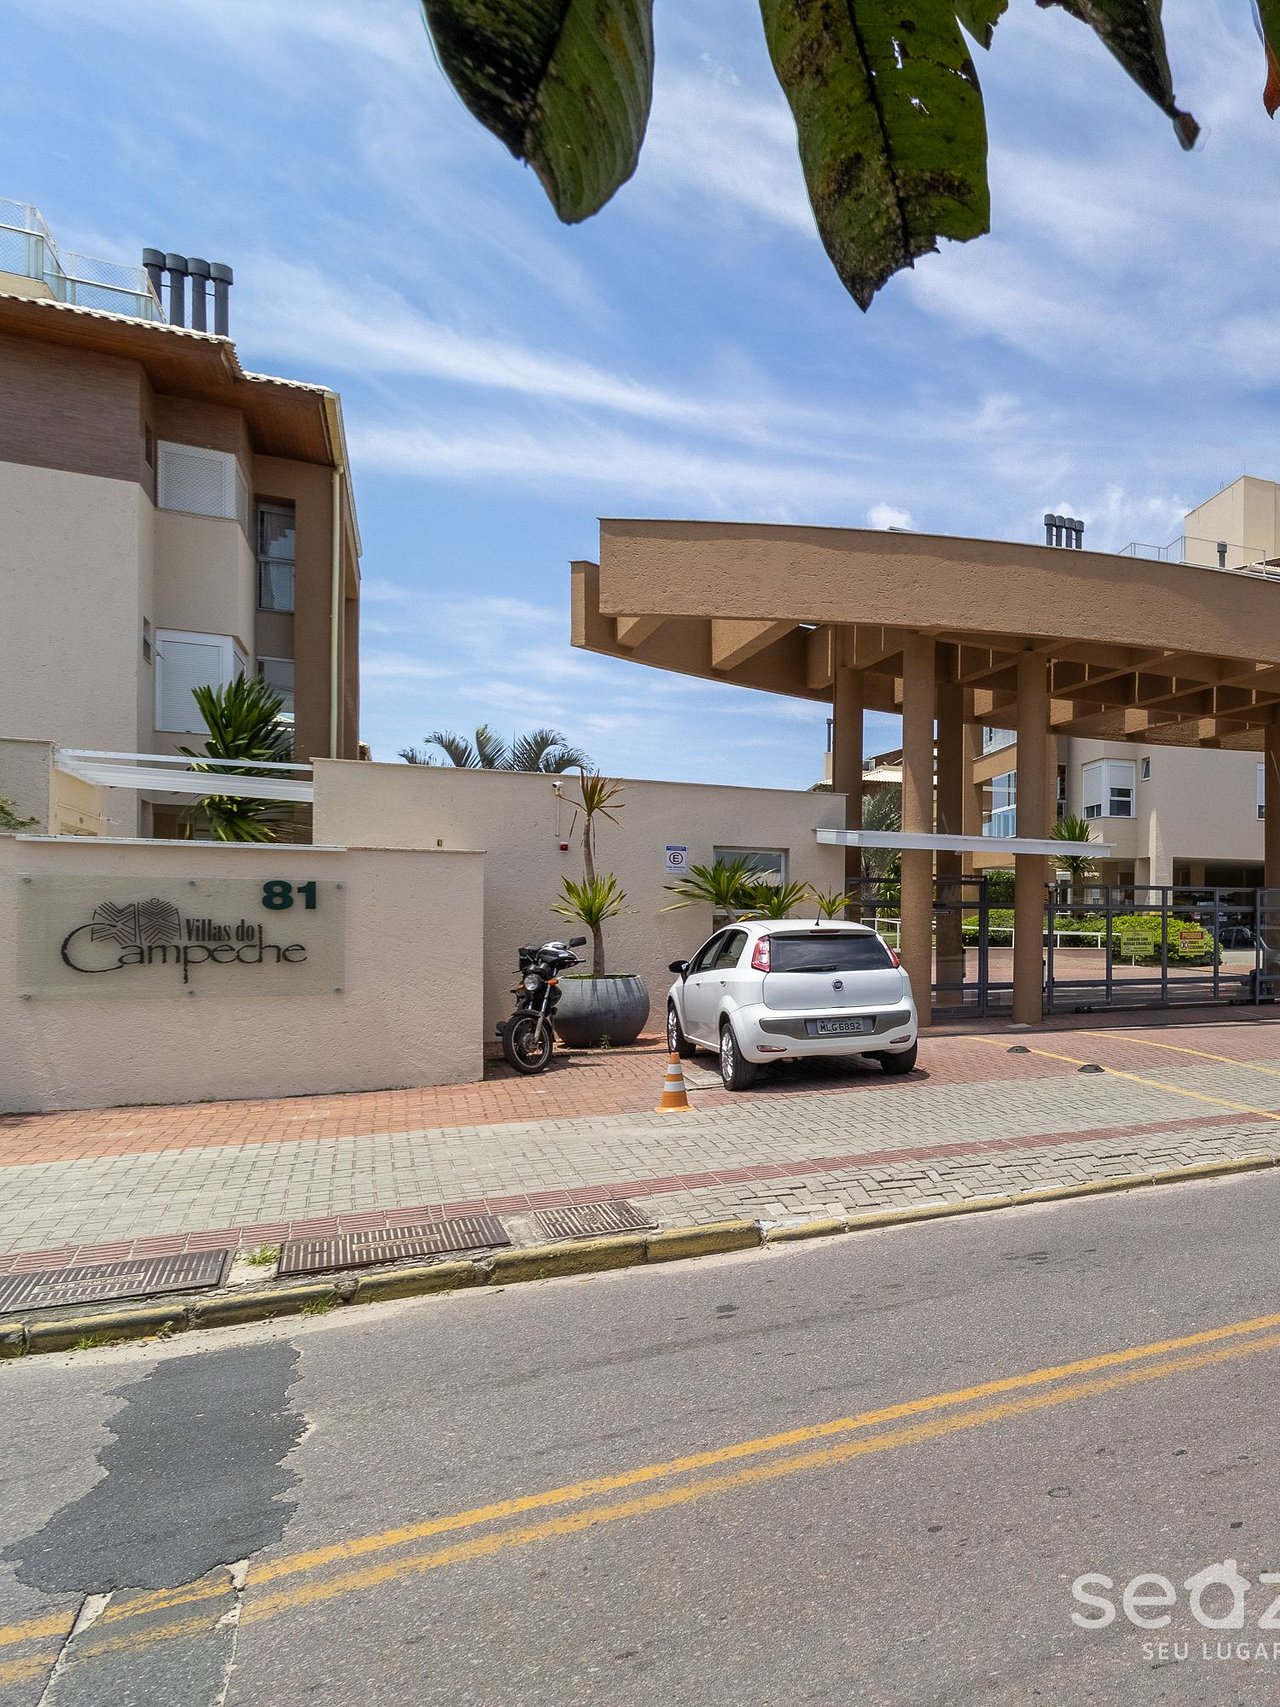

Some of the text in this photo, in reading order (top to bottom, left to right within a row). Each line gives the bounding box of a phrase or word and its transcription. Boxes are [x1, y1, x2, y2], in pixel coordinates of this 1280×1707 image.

[261, 880, 317, 909] 81
[185, 918, 255, 942] Villas do
[61, 922, 307, 984] Campeche
